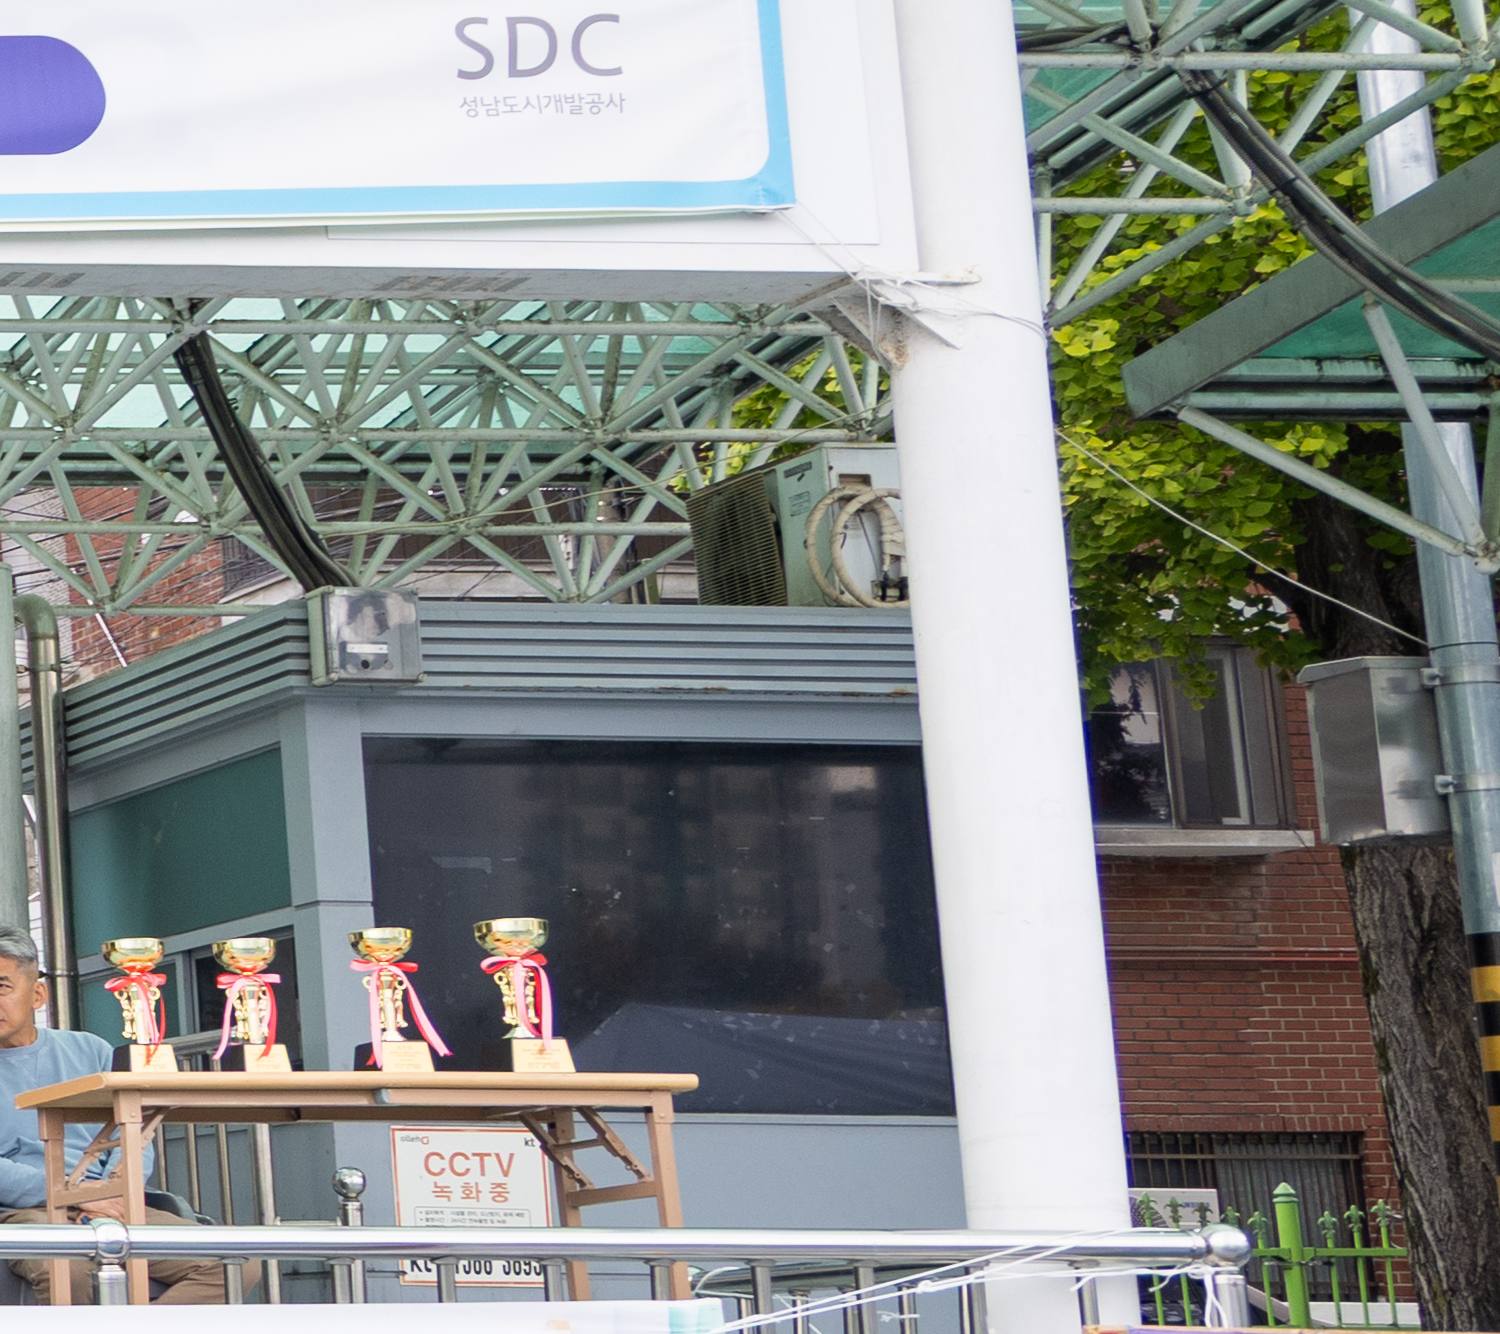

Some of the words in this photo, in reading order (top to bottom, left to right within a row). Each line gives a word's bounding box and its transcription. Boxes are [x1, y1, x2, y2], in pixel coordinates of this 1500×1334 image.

[454, 13, 623, 81] SDC
[458, 91, 627, 118] 성남도시개발공사
[524, 1137, 535, 1147] kt
[423, 1151, 515, 1177] CCTV
